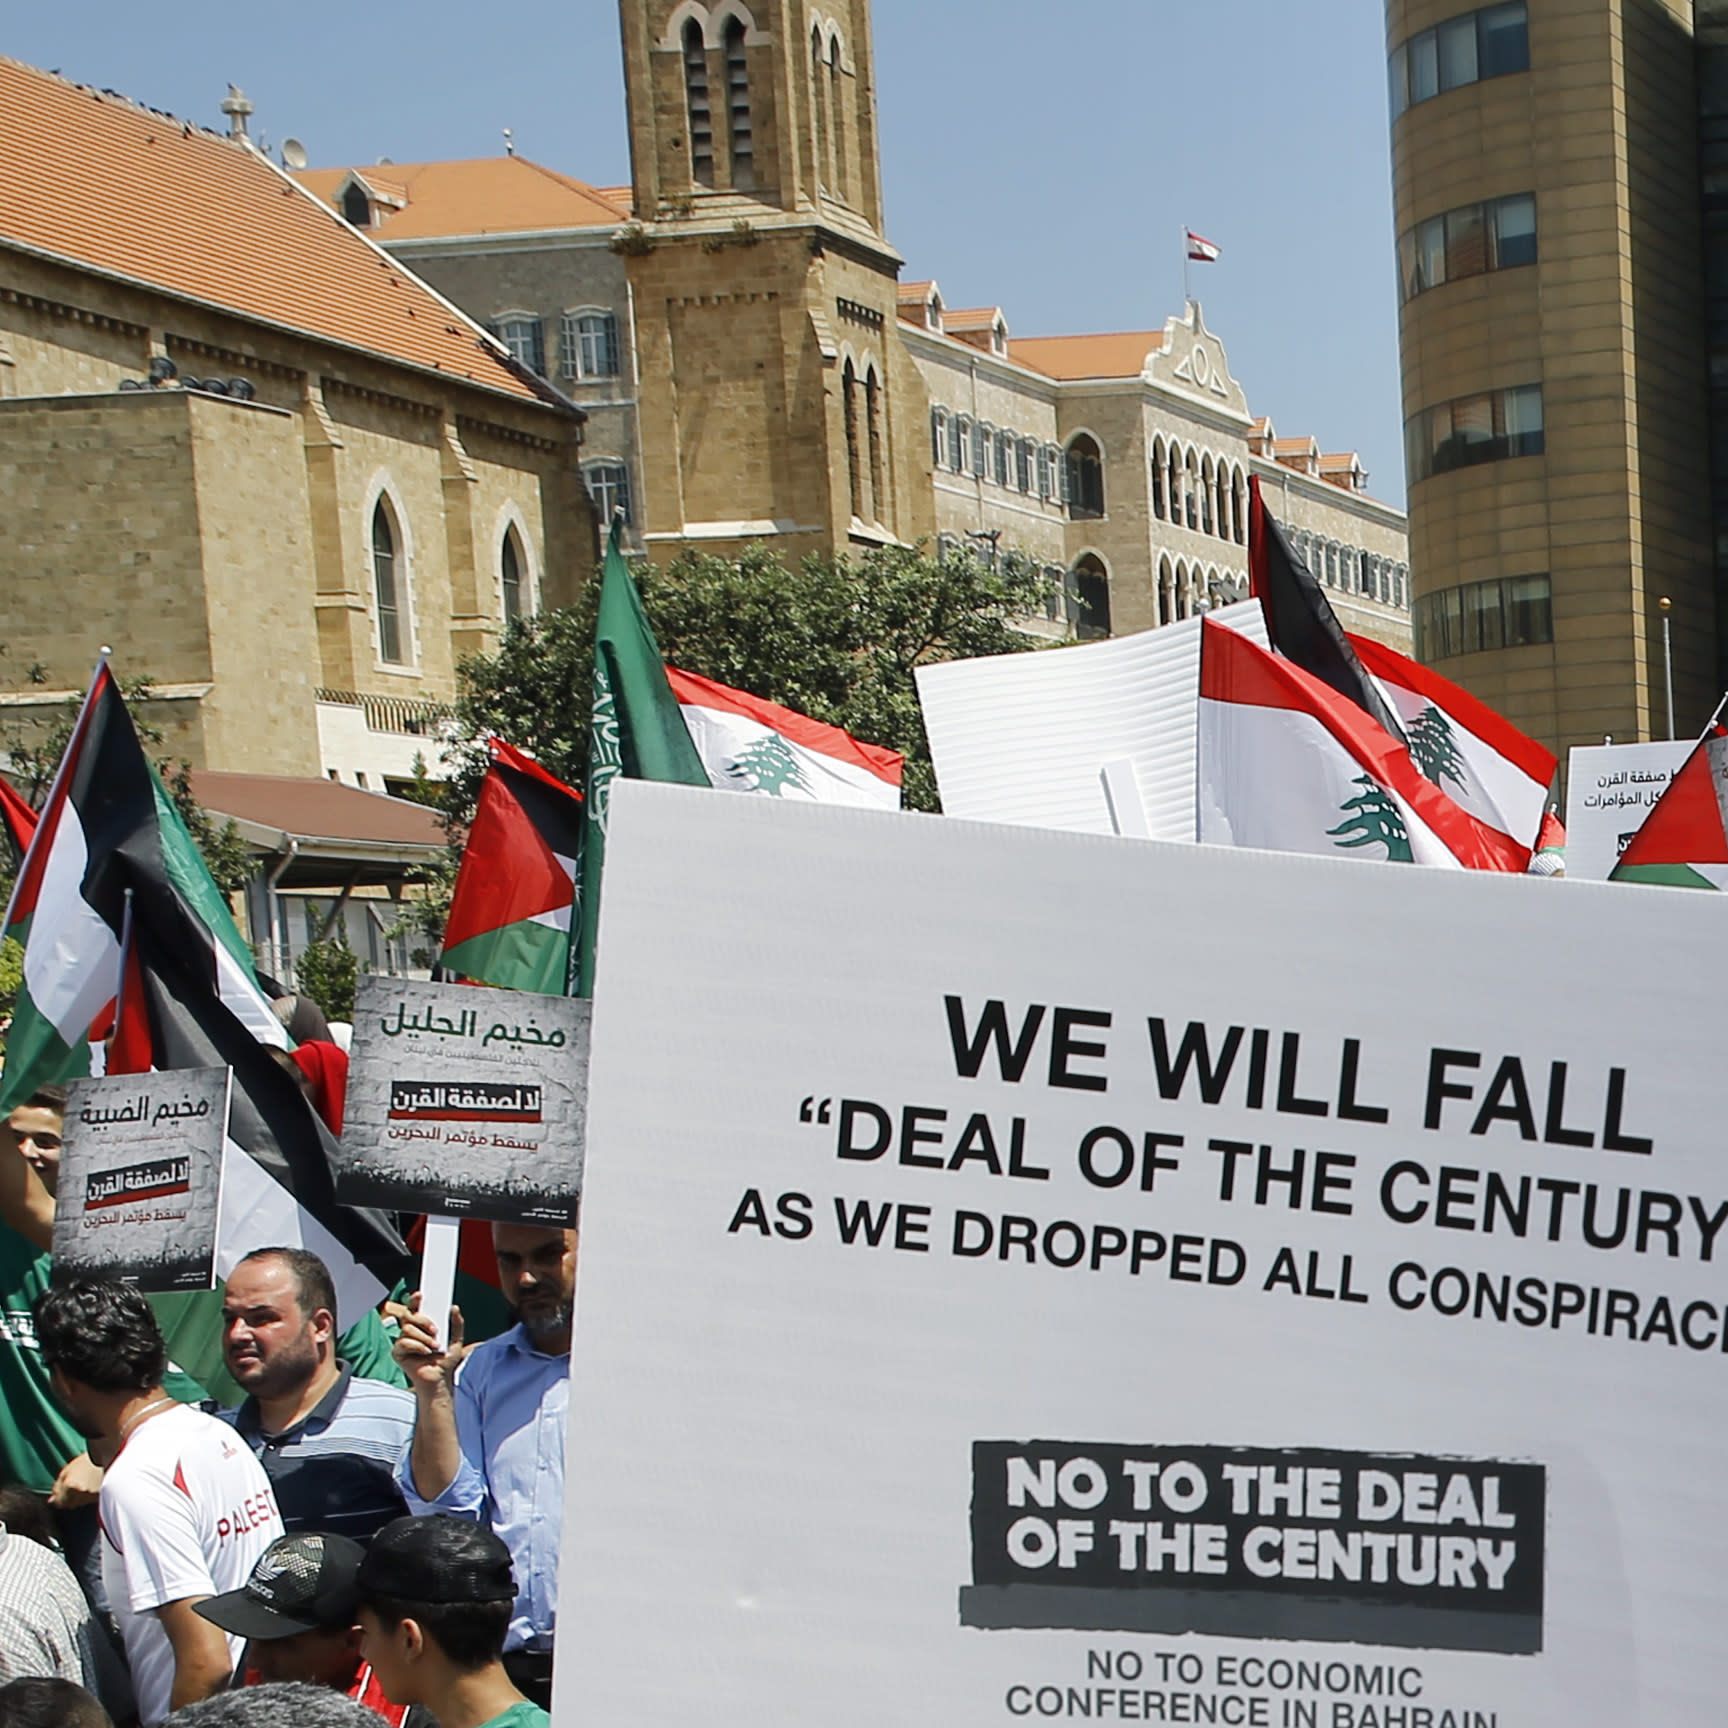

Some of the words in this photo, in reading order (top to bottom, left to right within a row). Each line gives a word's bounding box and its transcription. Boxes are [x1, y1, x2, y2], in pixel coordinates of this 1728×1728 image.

[1597, 771, 1628, 787] القرن
[1630, 771, 1666, 783] صفقة
[1584, 794, 1642, 808] المؤامرات
[381, 1002, 477, 1041] الجليل
[482, 1019, 566, 1050] مخيم
[944, 995, 1112, 1092] WE
[1148, 1017, 1388, 1123] WILL
[1424, 1048, 1653, 1155] FALL
[152, 1094, 209, 1127] مخيم
[392, 1088, 447, 1114] القرن
[447, 1088, 521, 1110] لصفقة
[523, 1089, 540, 1110] لا
[80, 1095, 150, 1132] الضبية
[388, 1126, 441, 1140] البحرين
[444, 1130, 488, 1148] مؤتمر
[491, 1134, 539, 1153] يسقط
[800, 1097, 1049, 1180] “DEAL
[1079, 1126, 1184, 1191] OF
[1208, 1139, 1356, 1215] THE
[124, 1163, 178, 1191] لصفقة
[177, 1160, 189, 1181] لا
[87, 1173, 124, 1202] القرن
[83, 1210, 121, 1228] البحرين
[121, 1211, 152, 1226] مؤتمر
[154, 1208, 187, 1222] يسقط
[728, 1189, 812, 1239] AS
[834, 1198, 931, 1252] WE
[953, 1210, 1246, 1285] DROPPED
[1263, 1247, 1368, 1303] ALL
[1007, 1458, 1107, 1509] NO
[1123, 1460, 1207, 1512] TO
[1222, 1464, 1341, 1518] THE
[1358, 1470, 1515, 1528] DEAL
[1007, 1517, 1094, 1568] OF
[1109, 1520, 1227, 1573] THE
[1243, 1526, 1515, 1589] CENTURY
[1088, 1650, 1142, 1680] NO
[1155, 1653, 1203, 1684] TO
[1217, 1656, 1422, 1697] ECONOMIC
[1006, 1686, 1269, 1727] CONFERENCE
